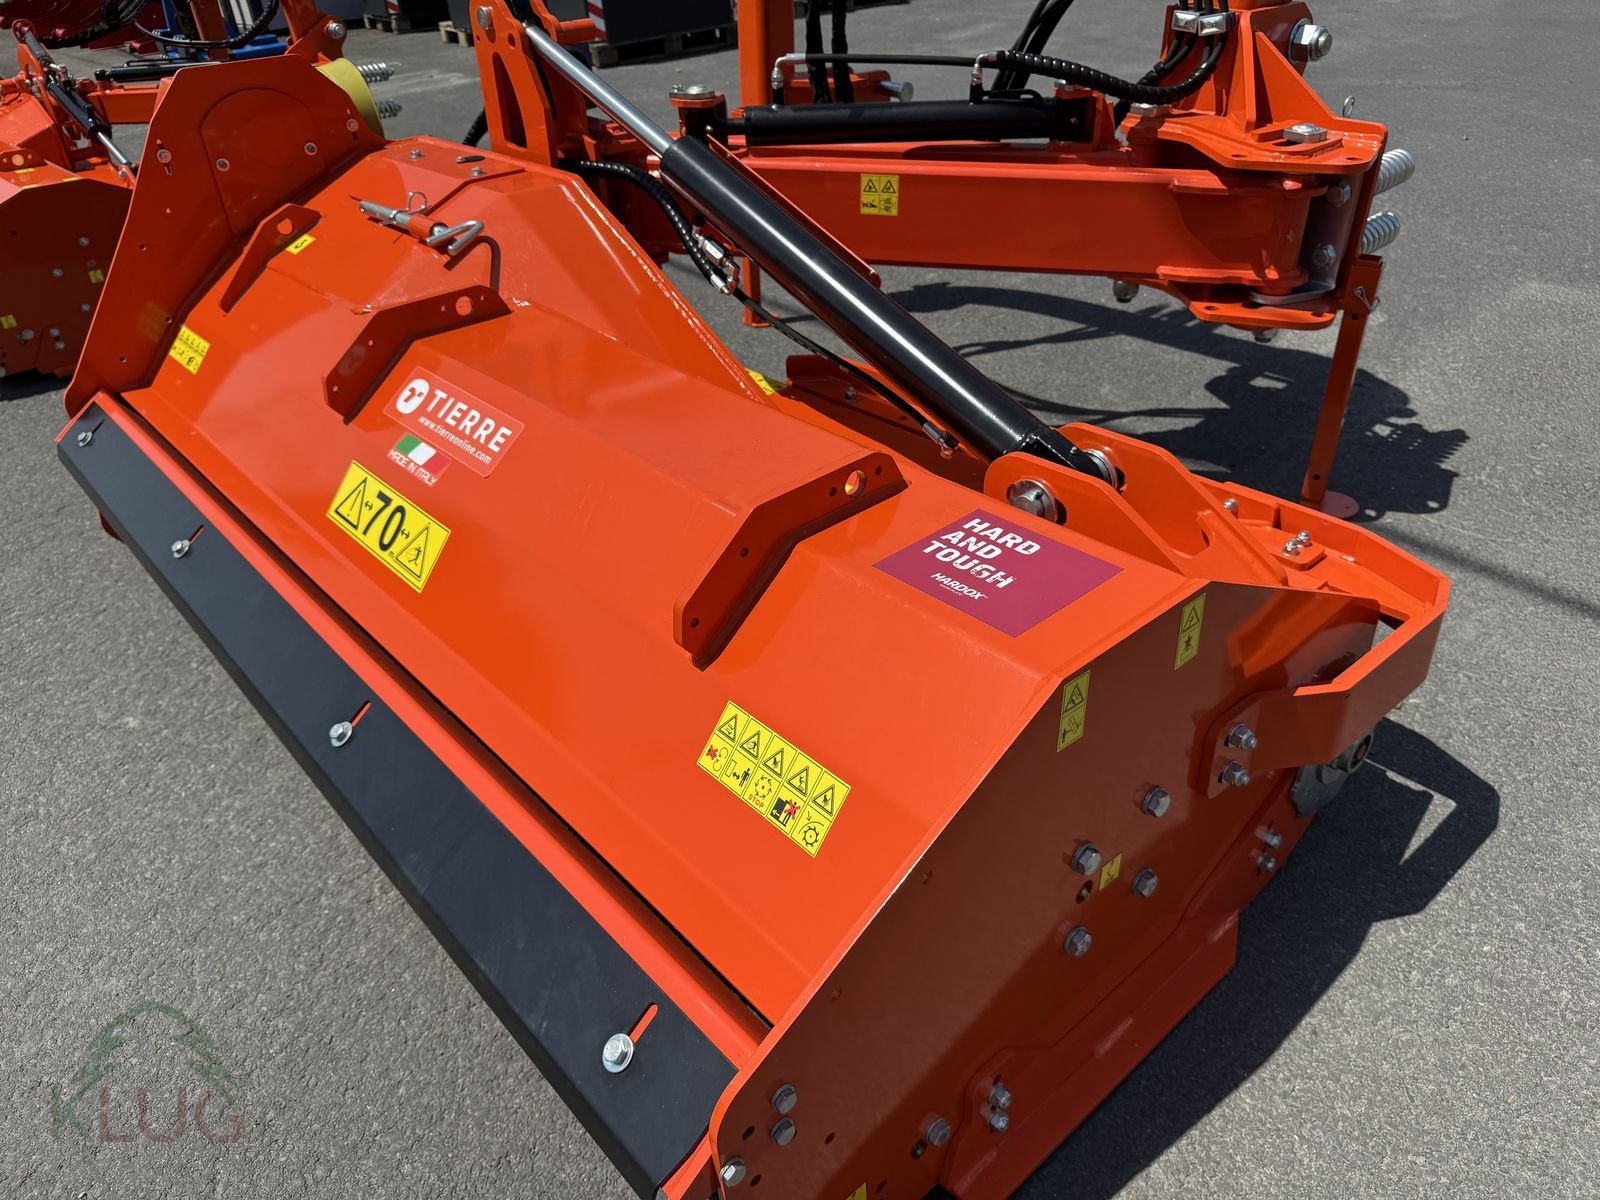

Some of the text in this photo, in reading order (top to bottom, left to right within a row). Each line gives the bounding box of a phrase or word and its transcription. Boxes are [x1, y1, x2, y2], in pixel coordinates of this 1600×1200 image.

[426, 389, 512, 453] TIERRE
[418, 416, 492, 464] www.tierreonline.com
[387, 449, 438, 486] MADE IN ITALY
[362, 490, 407, 552] 70
[962, 518, 1041, 555] HARD
[940, 530, 1002, 559] AND
[922, 540, 1015, 588] TOUGH
[930, 572, 984, 600] HARDOX
[748, 793, 764, 808] STOP
